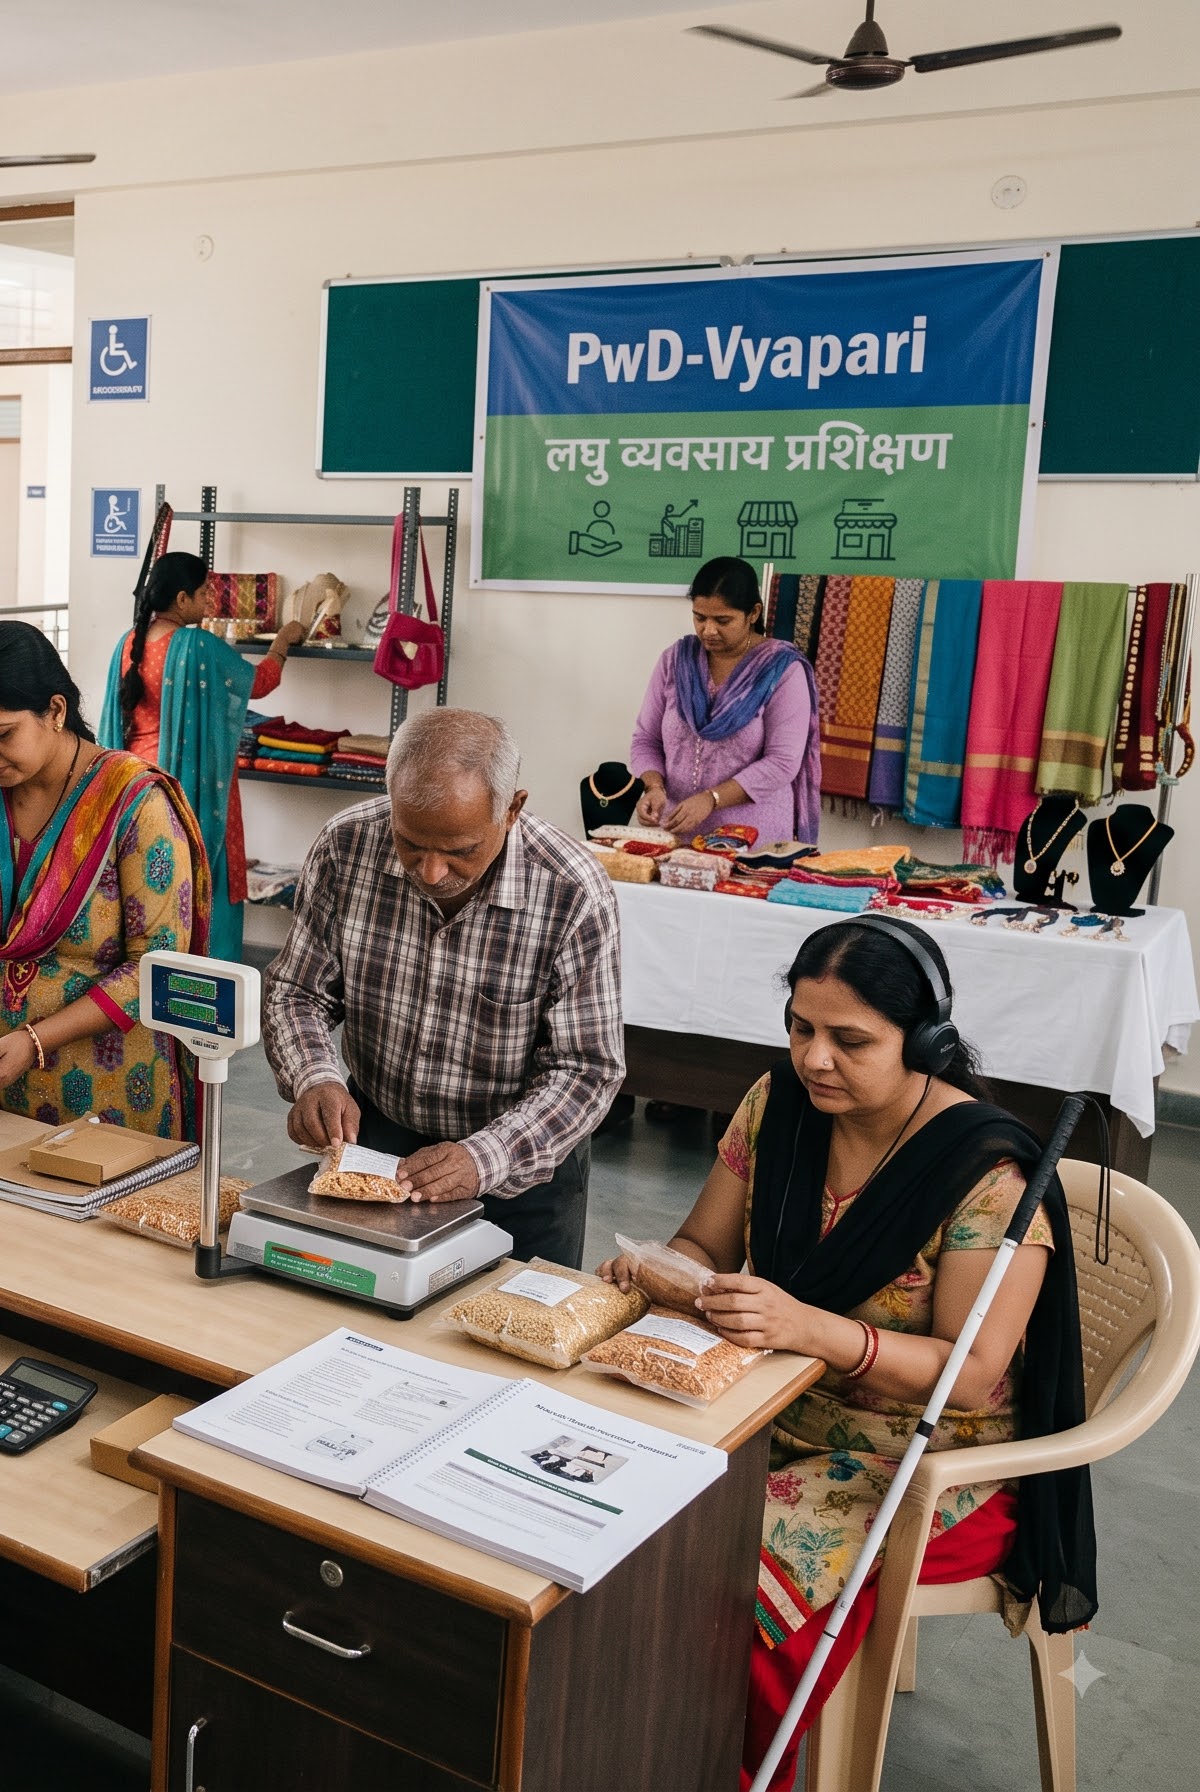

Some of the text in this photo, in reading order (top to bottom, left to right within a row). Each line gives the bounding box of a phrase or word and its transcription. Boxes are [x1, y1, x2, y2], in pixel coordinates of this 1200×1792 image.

[566, 315, 927, 392] PwD-Vyapari
[545, 420, 953, 486] लघु व्यवसाय प्रशिक्षण
